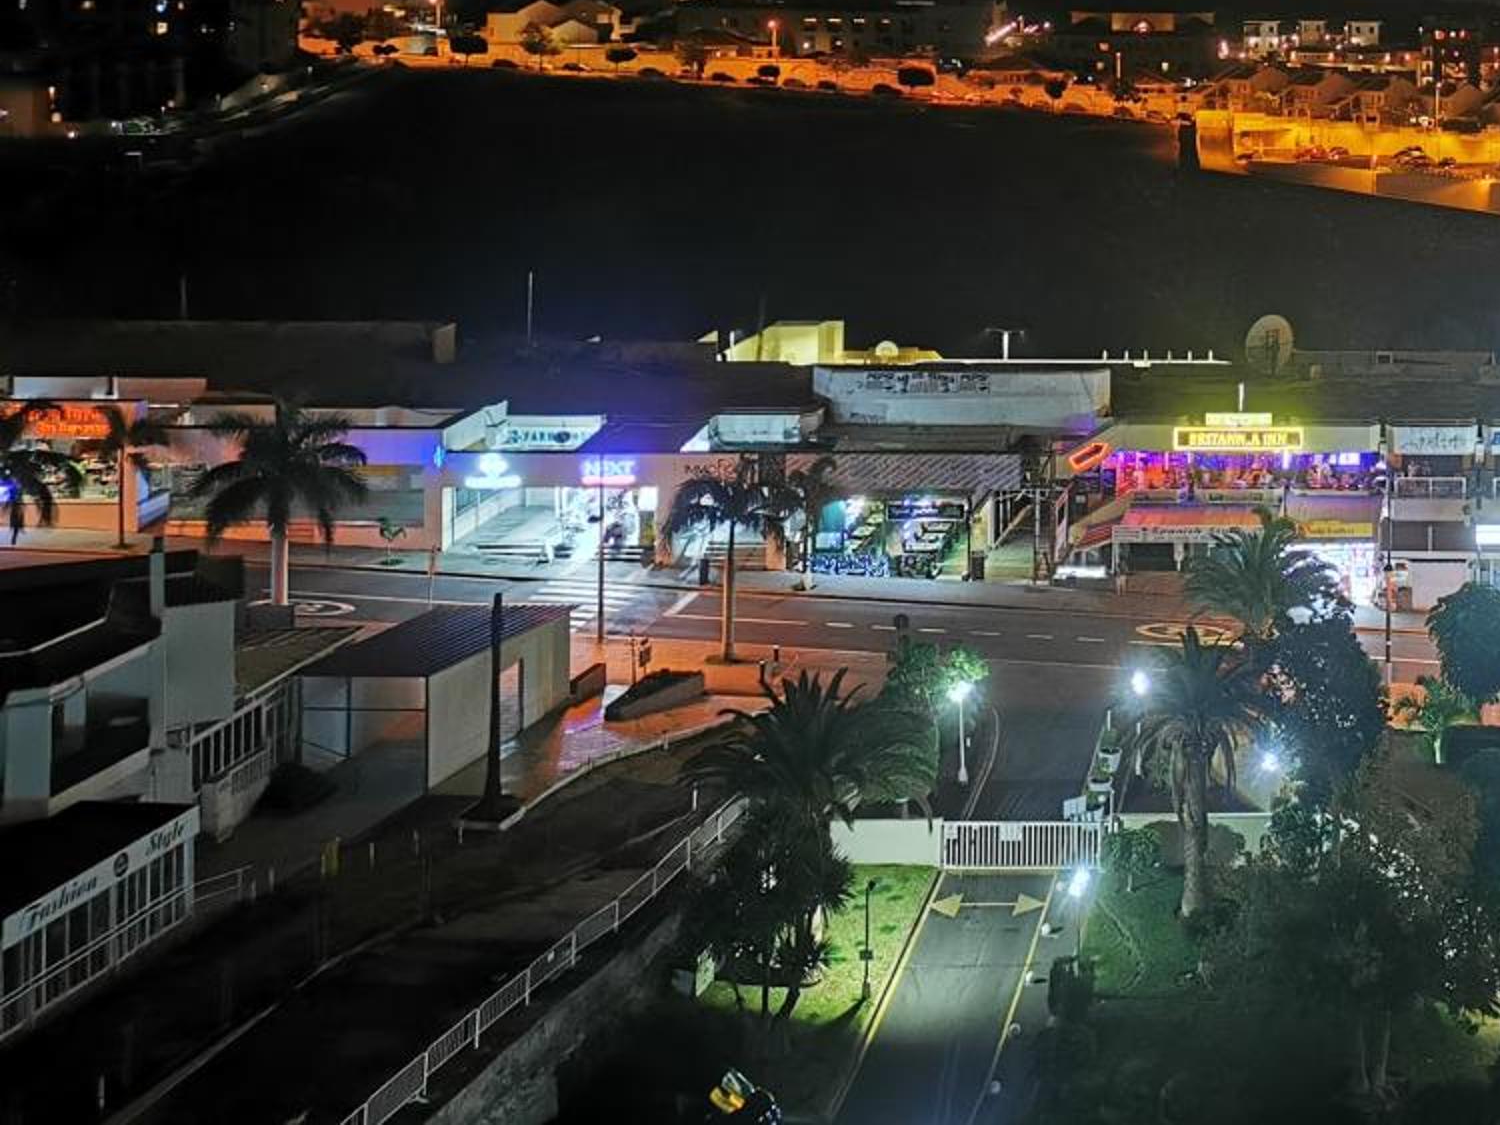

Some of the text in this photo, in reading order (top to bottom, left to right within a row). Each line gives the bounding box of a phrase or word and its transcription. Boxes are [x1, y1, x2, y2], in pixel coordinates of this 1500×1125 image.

[1188, 432, 1288, 446] BRITANNA INN
[582, 460, 637, 476] NEXT
[20, 876, 97, 931] Fashion
